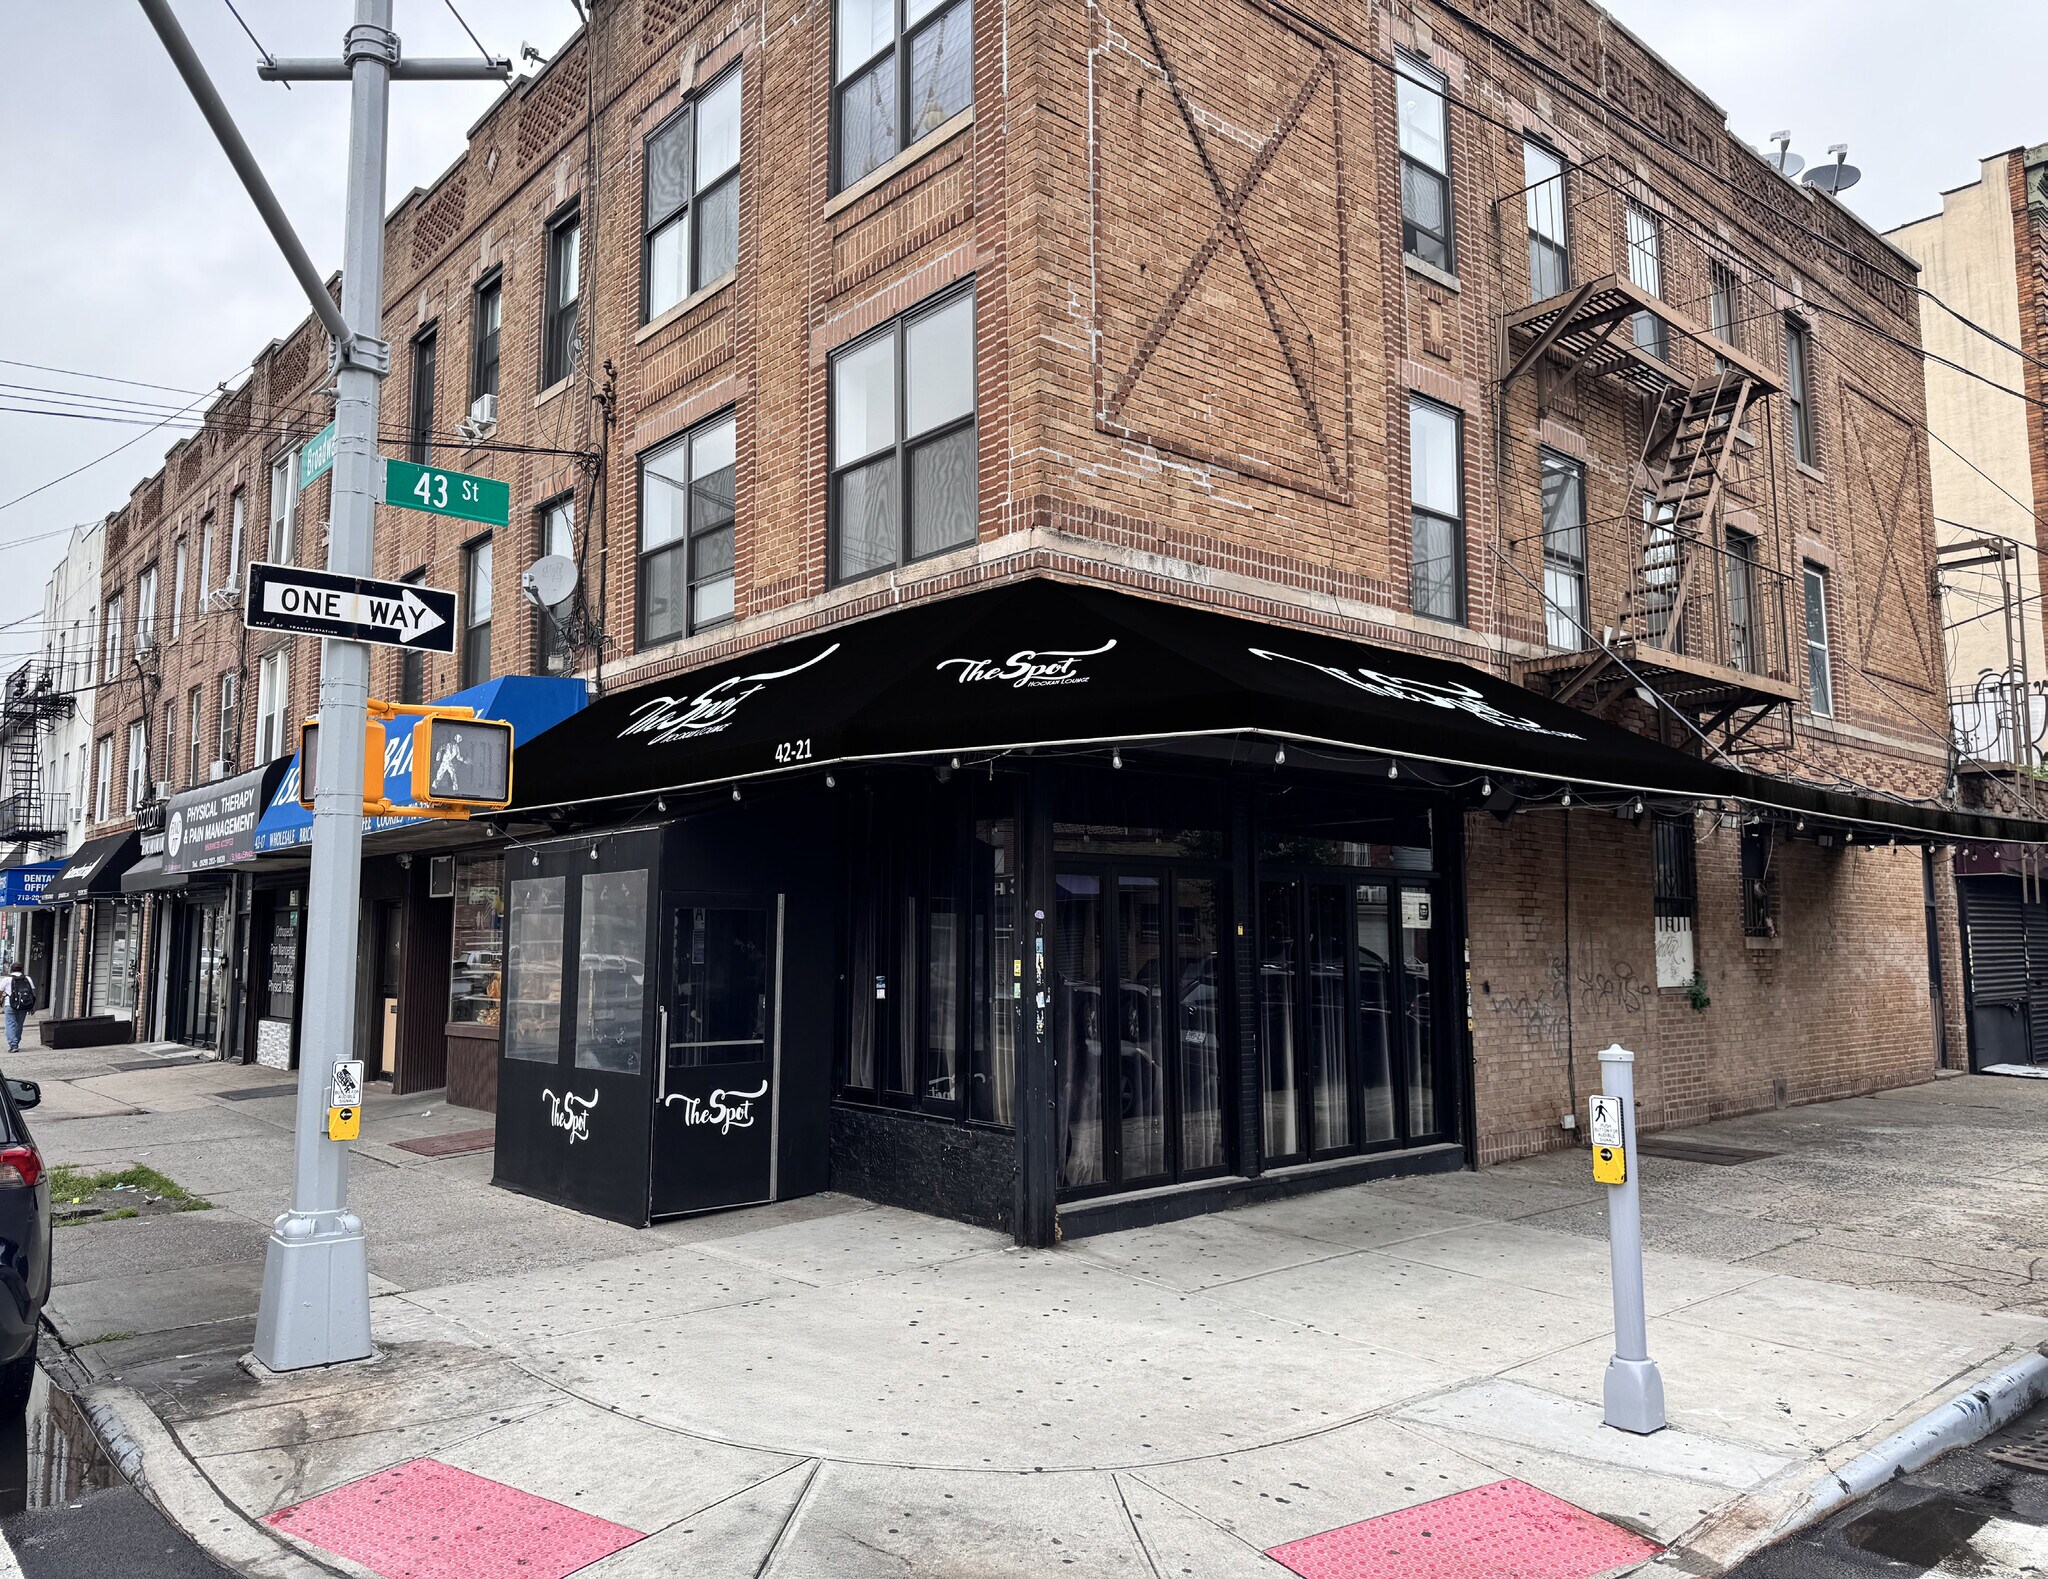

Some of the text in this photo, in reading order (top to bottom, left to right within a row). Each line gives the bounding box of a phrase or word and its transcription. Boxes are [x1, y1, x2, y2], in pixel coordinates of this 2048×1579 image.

[307, 434, 336, 477] Broadwa
[413, 472, 479, 509] 43 St
[280, 587, 427, 630] ONE WAY
[289, 625, 338, 634] TRANSPORTATION
[936, 639, 1117, 688] The Spot
[775, 738, 812, 763] 42-21
[186, 788, 255, 823] PHYSICAL THERAPY
[183, 829, 189, 844] &
[189, 826, 205, 844] PAIN
[205, 812, 255, 841] MANAGEMENT
[269, 829, 296, 847] WHOLESALE
[24, 883, 48, 892] OFFI
[542, 1088, 599, 1144] The Spot
[665, 1079, 768, 1135] The Spot
